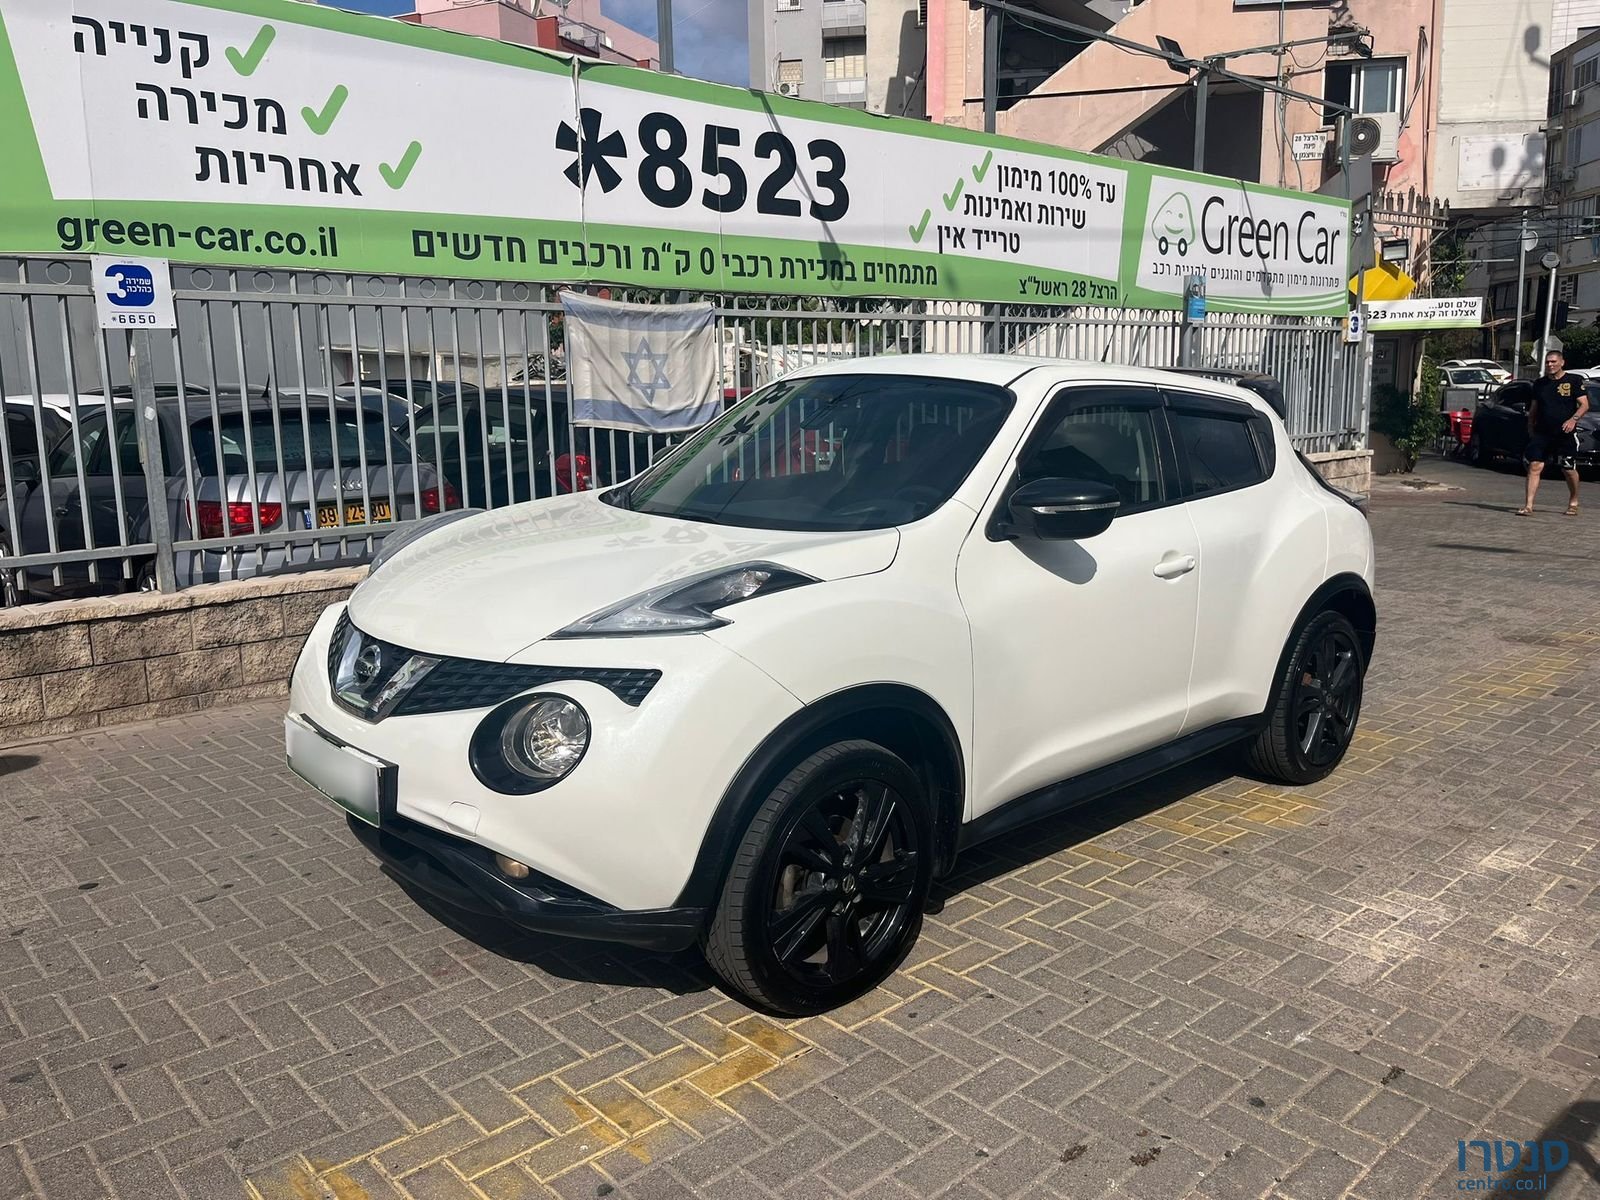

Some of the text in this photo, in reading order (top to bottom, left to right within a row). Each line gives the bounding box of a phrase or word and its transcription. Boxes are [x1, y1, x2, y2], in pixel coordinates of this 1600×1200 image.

[72, 15, 209, 79] קנייה
[135, 82, 287, 136] מכירה
[195, 146, 363, 197] אחריות
[996, 164, 1116, 203] עד 100% מימון
[964, 193, 1086, 229] שירות ואמינות
[56, 216, 338, 258] green-car.co.il
[937, 225, 1021, 254] טרייד אין
[1201, 196, 1341, 265] Green Car
[412, 229, 527, 263] חדשים
[538, 239, 632, 270] ורכבים
[700, 247, 715, 275] 0
[722, 253, 773, 278] רכבי
[779, 256, 857, 282] במכירת
[863, 261, 938, 286] מתמחים
[1152, 262, 1171, 276] רכב
[125, 277, 151, 285] שמירה
[1211, 267, 1243, 281] והוגנים
[1246, 270, 1284, 286] מתקדמים
[1287, 273, 1308, 288] מימון
[1310, 275, 1340, 288] פתרונות
[126, 285, 152, 293] כהלכה
[1018, 275, 1118, 301] הרצל 28 ראשל"צ
[1389, 311, 1414, 319] אחרת
[1417, 310, 1436, 320] קצת
[1438, 309, 1448, 317] זה
[1451, 308, 1477, 317] אצלנו
[1456, 300, 1477, 309] שלם
